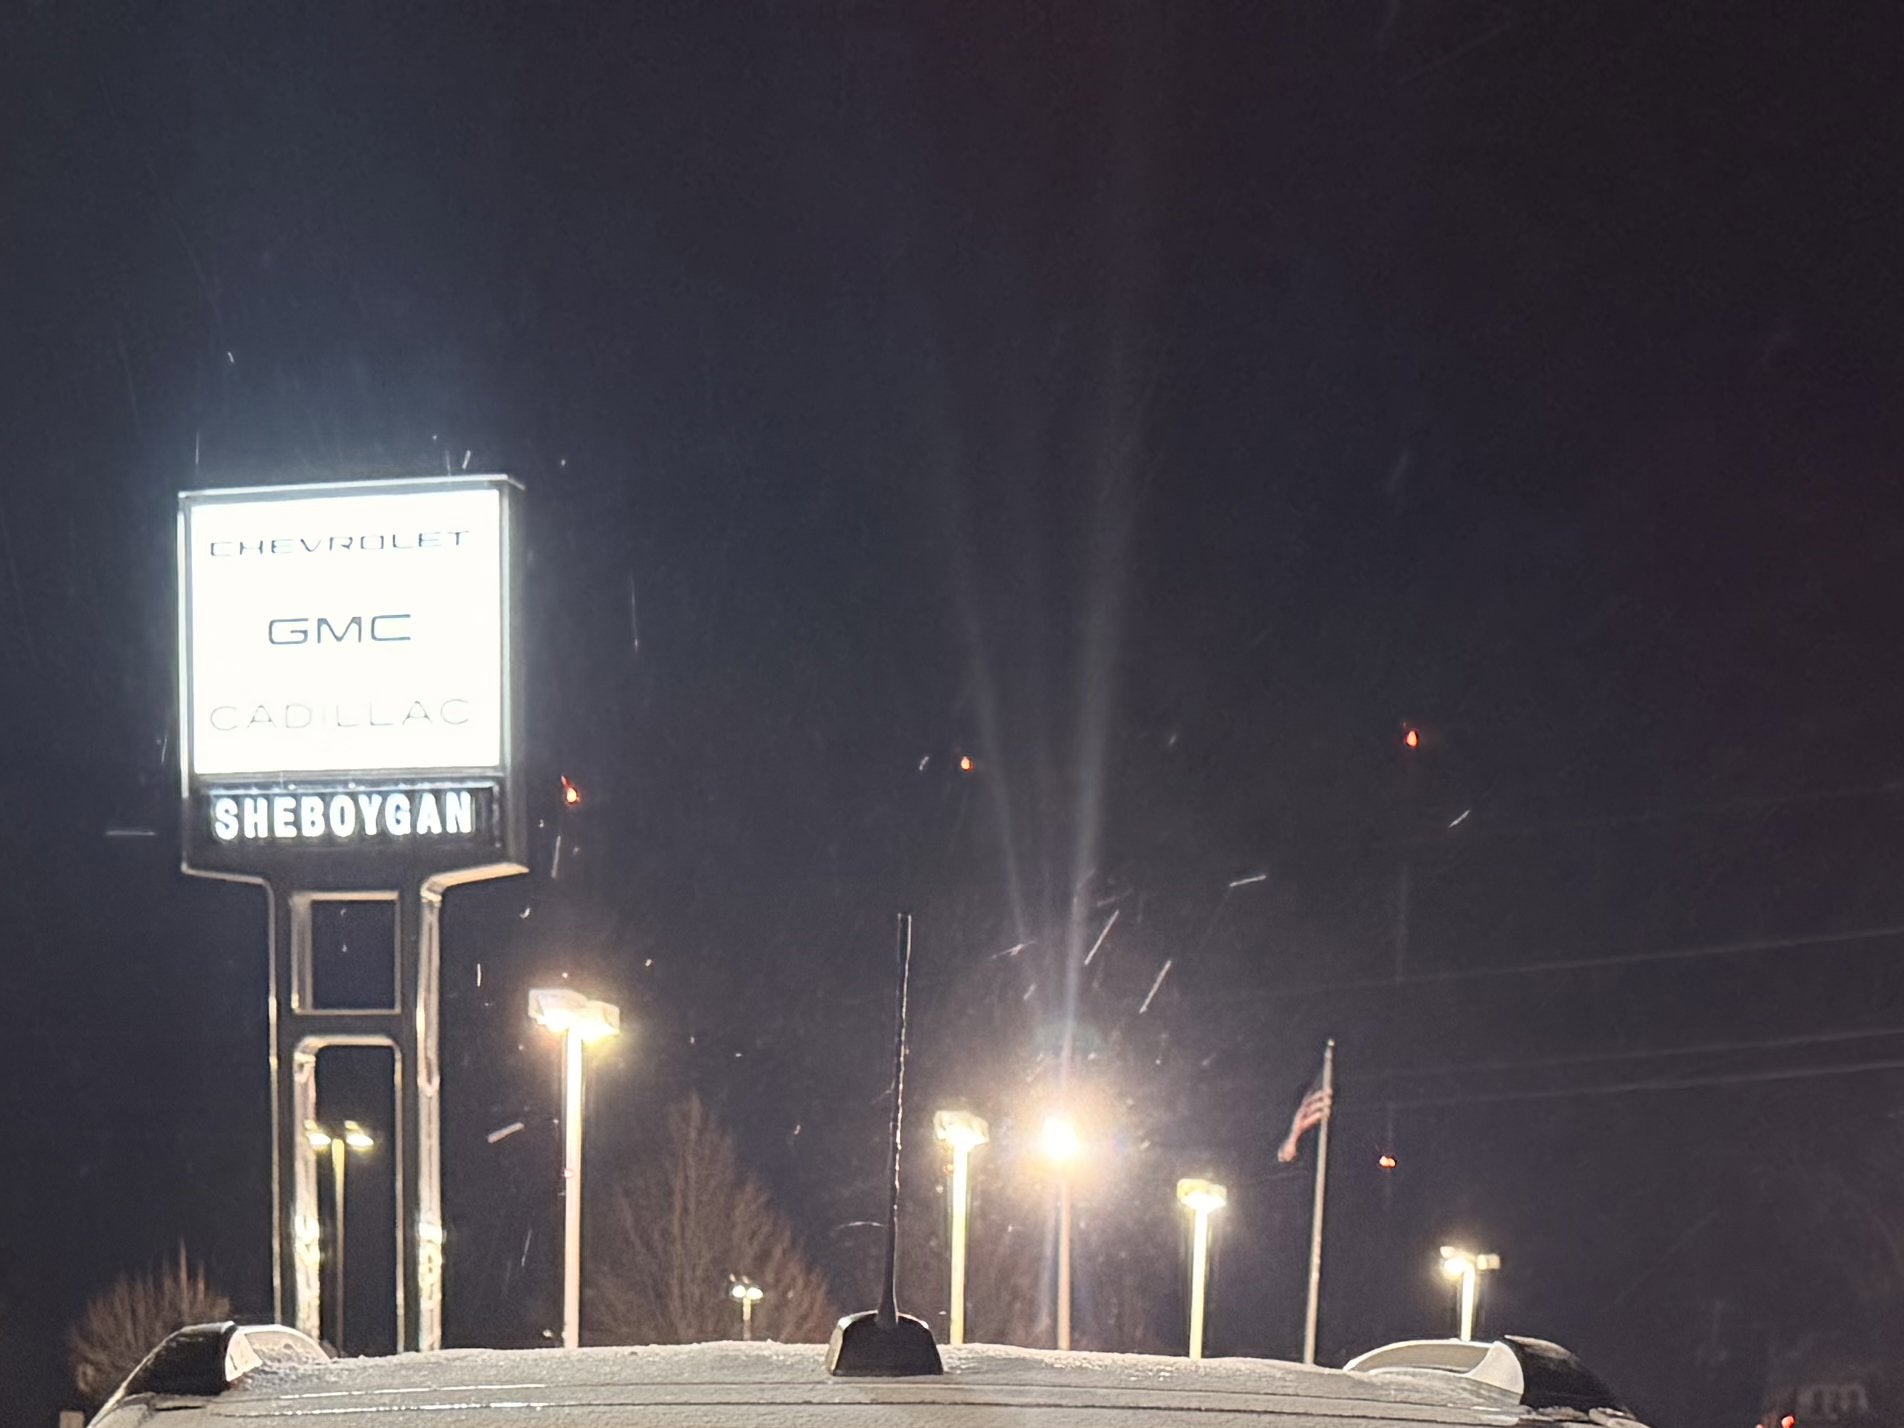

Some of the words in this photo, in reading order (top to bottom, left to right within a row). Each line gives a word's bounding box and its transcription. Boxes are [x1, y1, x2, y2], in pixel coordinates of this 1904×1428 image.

[209, 530, 470, 557] CHEVROLET
[268, 614, 411, 645] GMC
[209, 699, 471, 731] CADILLAC
[213, 791, 473, 841] SHEBOYGAN
